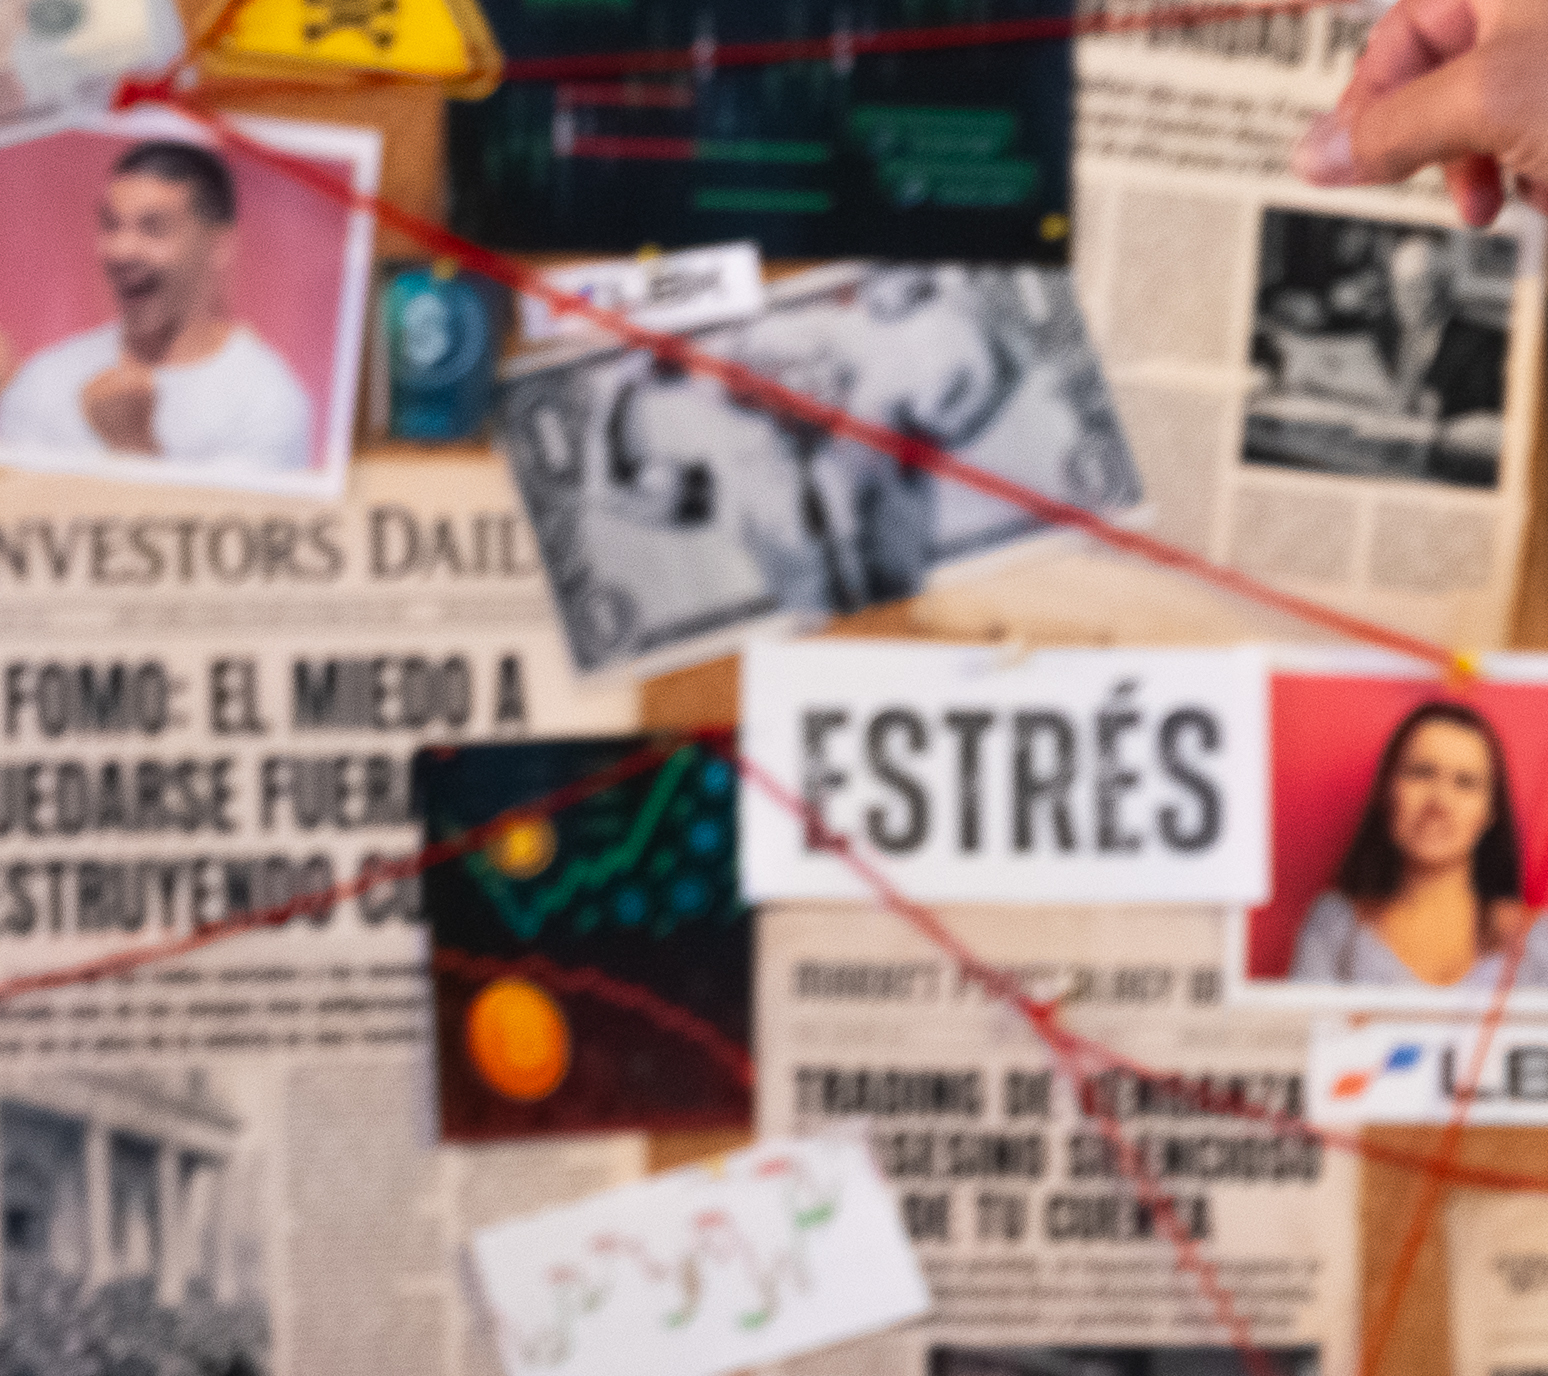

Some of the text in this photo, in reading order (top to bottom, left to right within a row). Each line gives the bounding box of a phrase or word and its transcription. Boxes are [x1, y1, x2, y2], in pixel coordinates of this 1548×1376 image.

[5, 651, 528, 735] FOMO: EL MIEDO A
[797, 676, 1225, 857] ESTRÉS
[872, 1131, 1047, 1182] SESINO
